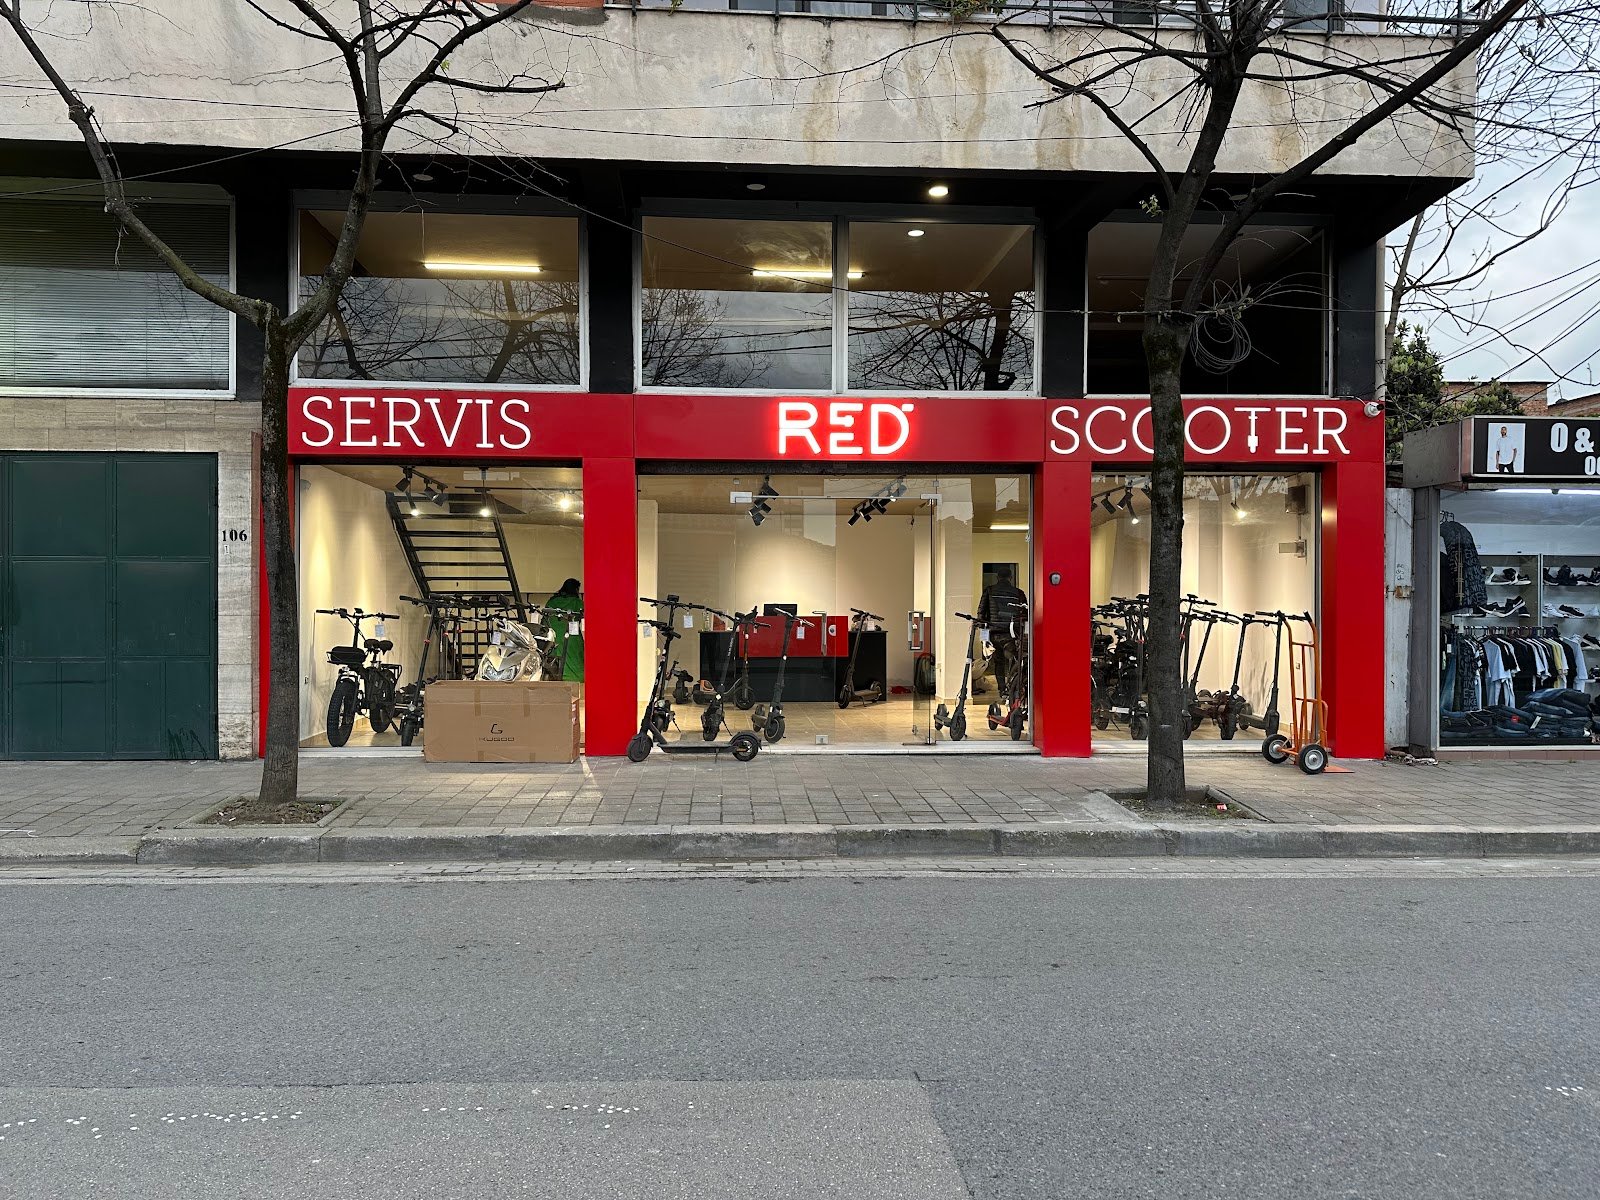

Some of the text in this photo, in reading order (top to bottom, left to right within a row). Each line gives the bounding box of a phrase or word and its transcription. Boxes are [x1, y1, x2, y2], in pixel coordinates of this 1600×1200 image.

[302, 395, 531, 449] SERVIS
[778, 402, 914, 454] RED
[1574, 427, 1595, 453] &
[222, 529, 247, 541] 106
